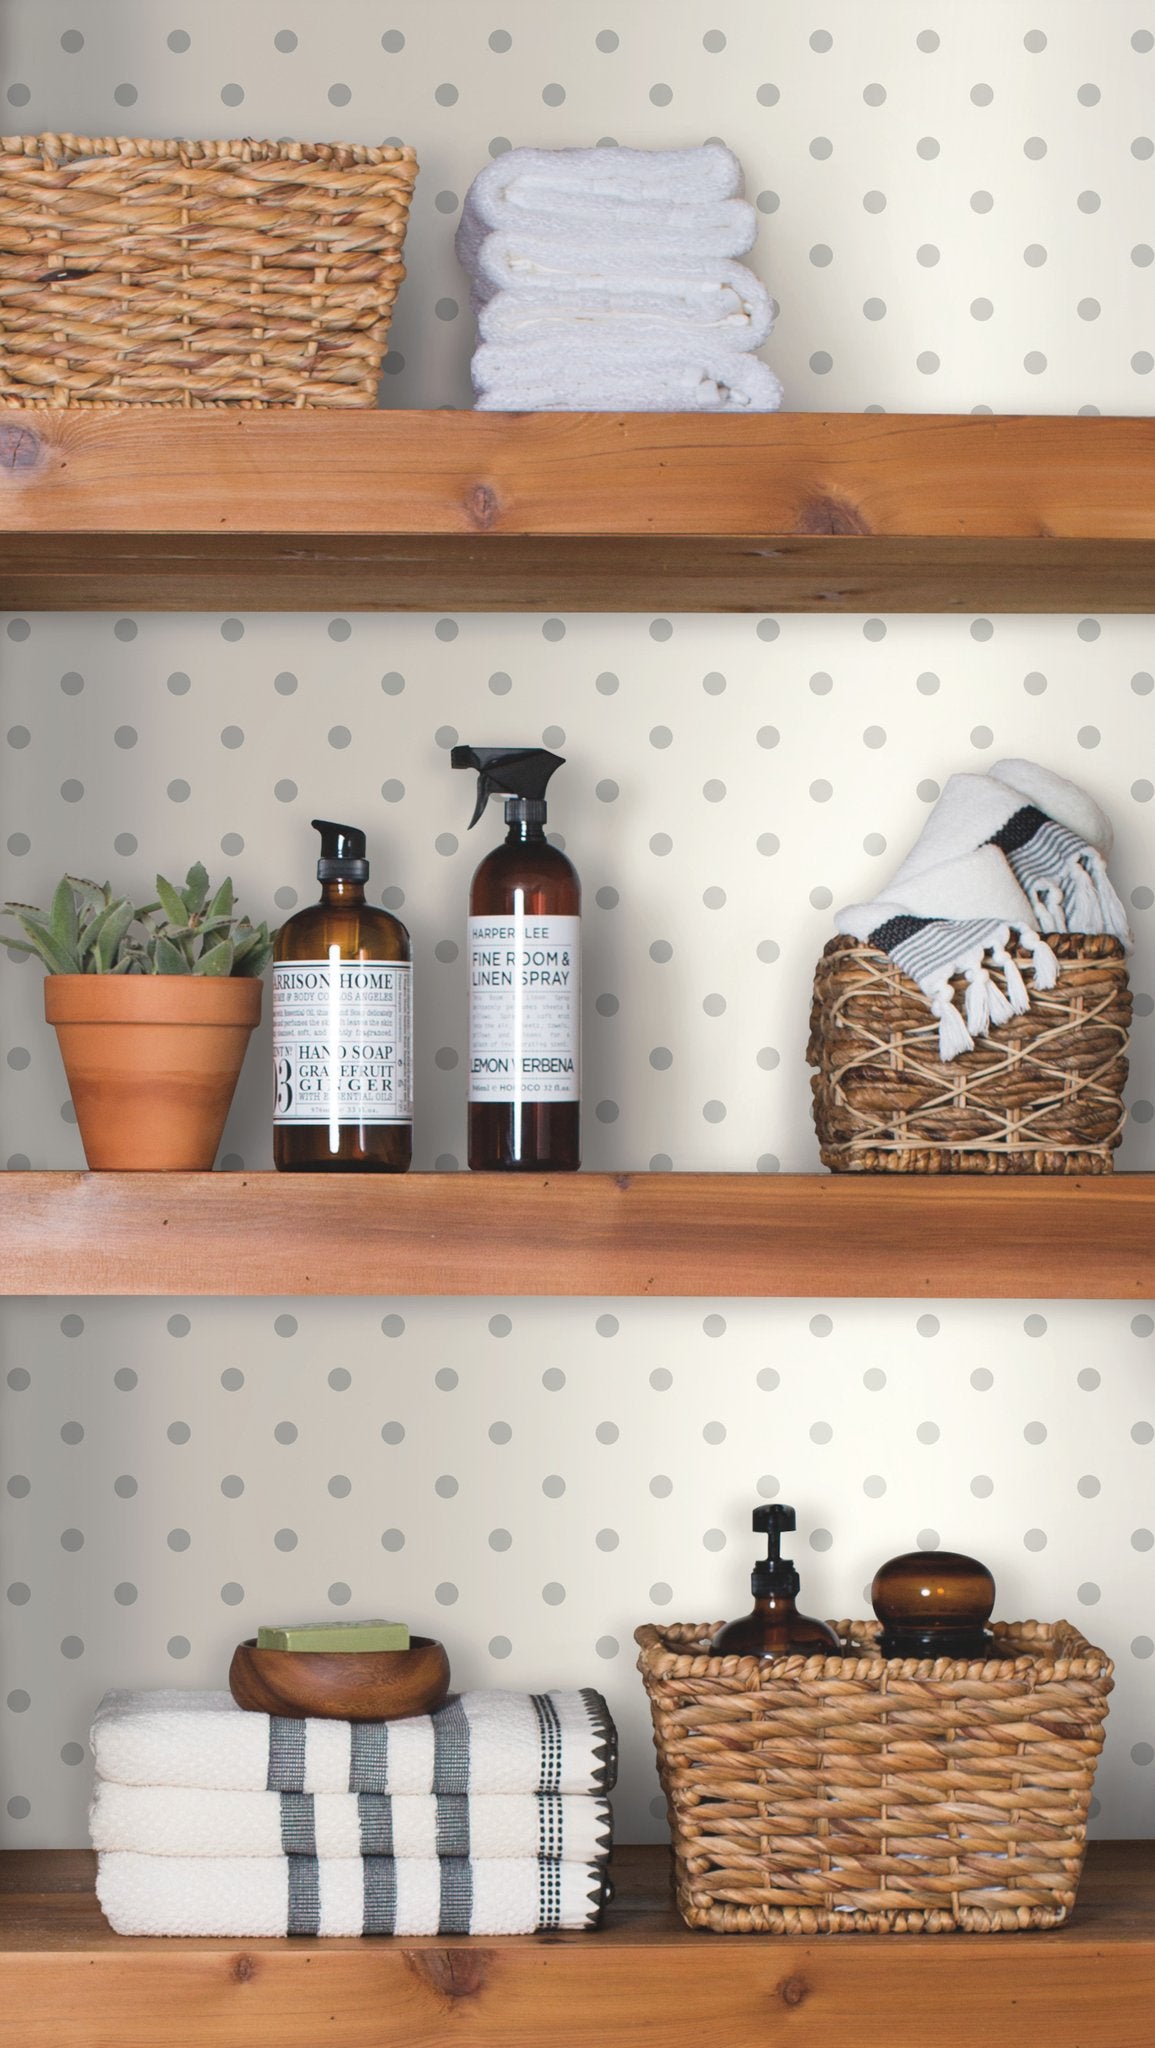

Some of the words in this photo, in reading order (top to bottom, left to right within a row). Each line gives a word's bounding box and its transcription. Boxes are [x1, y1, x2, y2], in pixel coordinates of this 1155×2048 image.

[473, 928, 515, 939] HARPER
[525, 928, 549, 939] LEE
[473, 952, 501, 966] FINE
[562, 952, 570, 966] &
[340, 973, 393, 990] HOME
[473, 971, 512, 986] LINEN
[522, 971, 571, 986] SPRAY
[294, 992, 315, 1001] BODY
[340, 992, 353, 1001] OS
[352, 1046, 393, 1060] SOAP
[299, 1065, 394, 1078] GRAEFRUIT
[471, 1058, 508, 1073] LEMON
[323, 1092, 372, 1101] EENTAL
[376, 1092, 393, 1101] OILS
